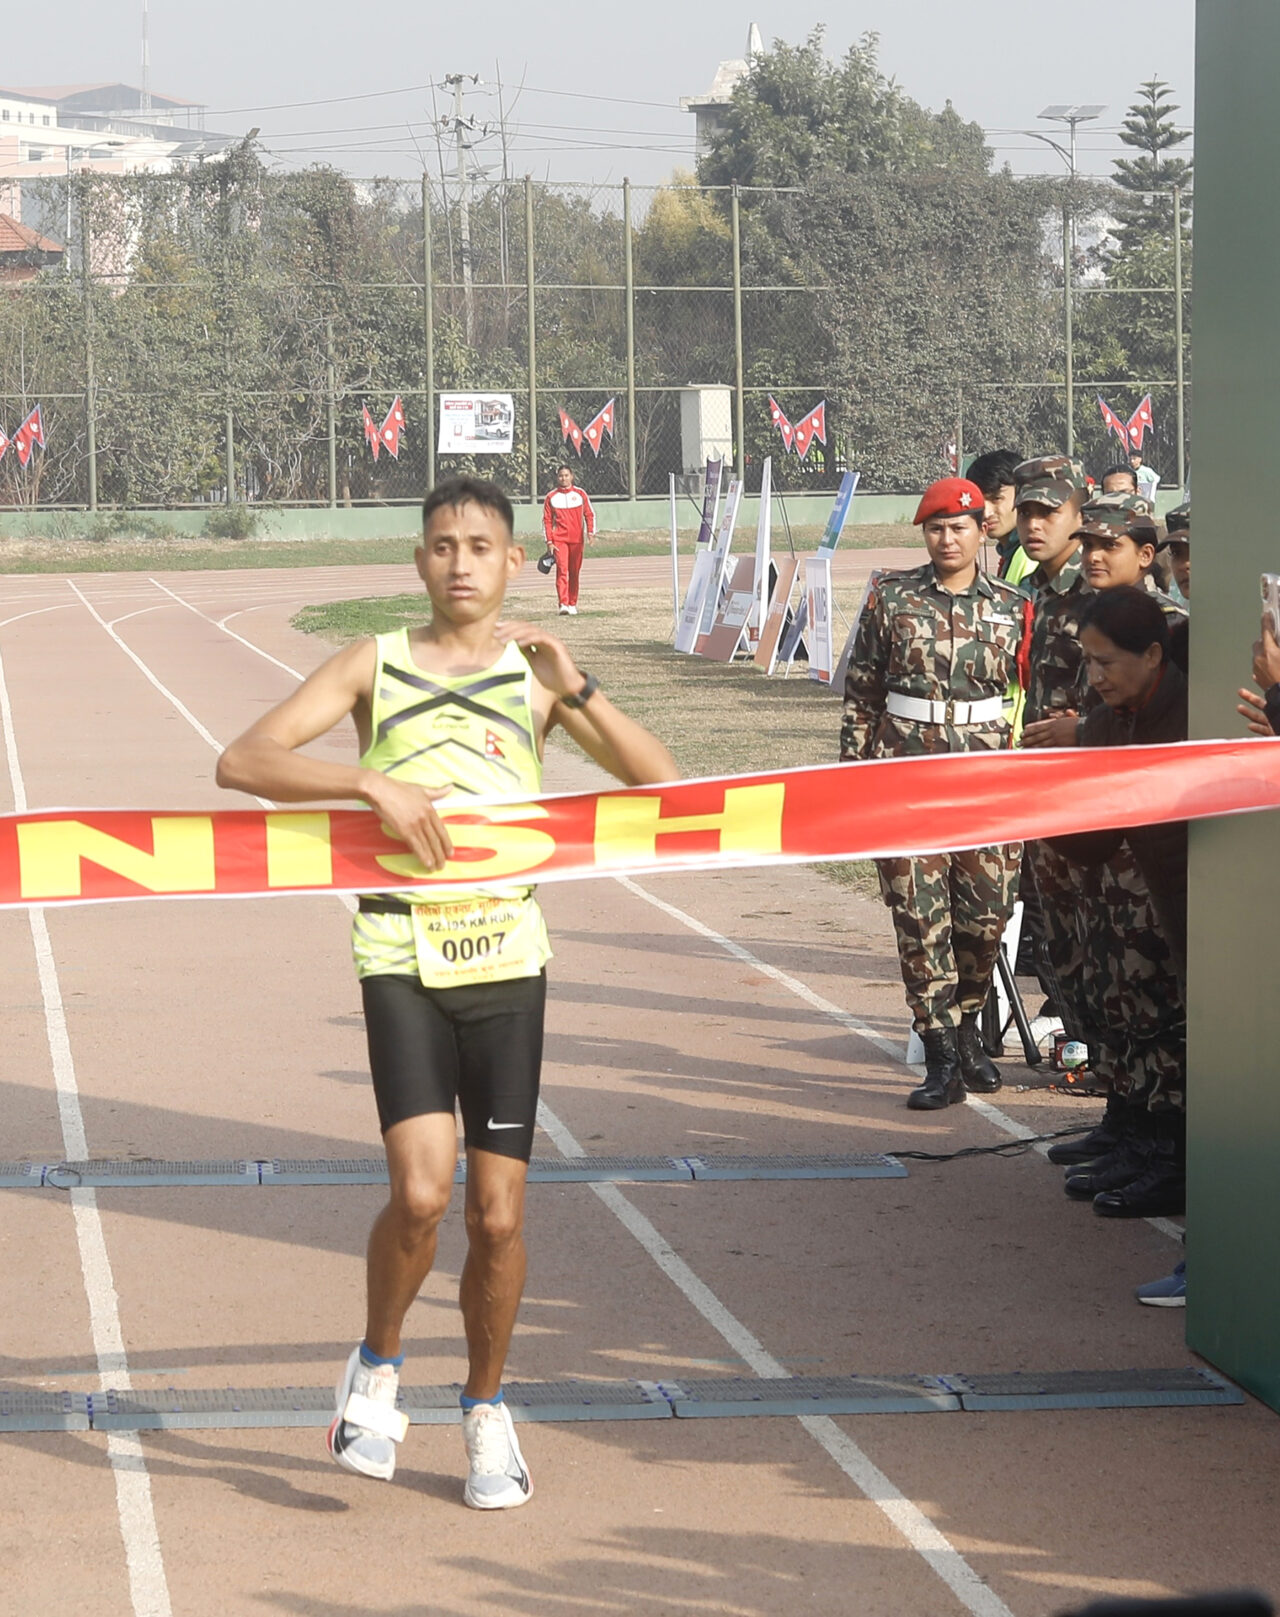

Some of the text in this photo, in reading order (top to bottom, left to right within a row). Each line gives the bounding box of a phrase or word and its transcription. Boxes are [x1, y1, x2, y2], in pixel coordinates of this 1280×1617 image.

[428, 912, 515, 932] 42.195 KM RUN
[442, 932, 506, 963] 0007
